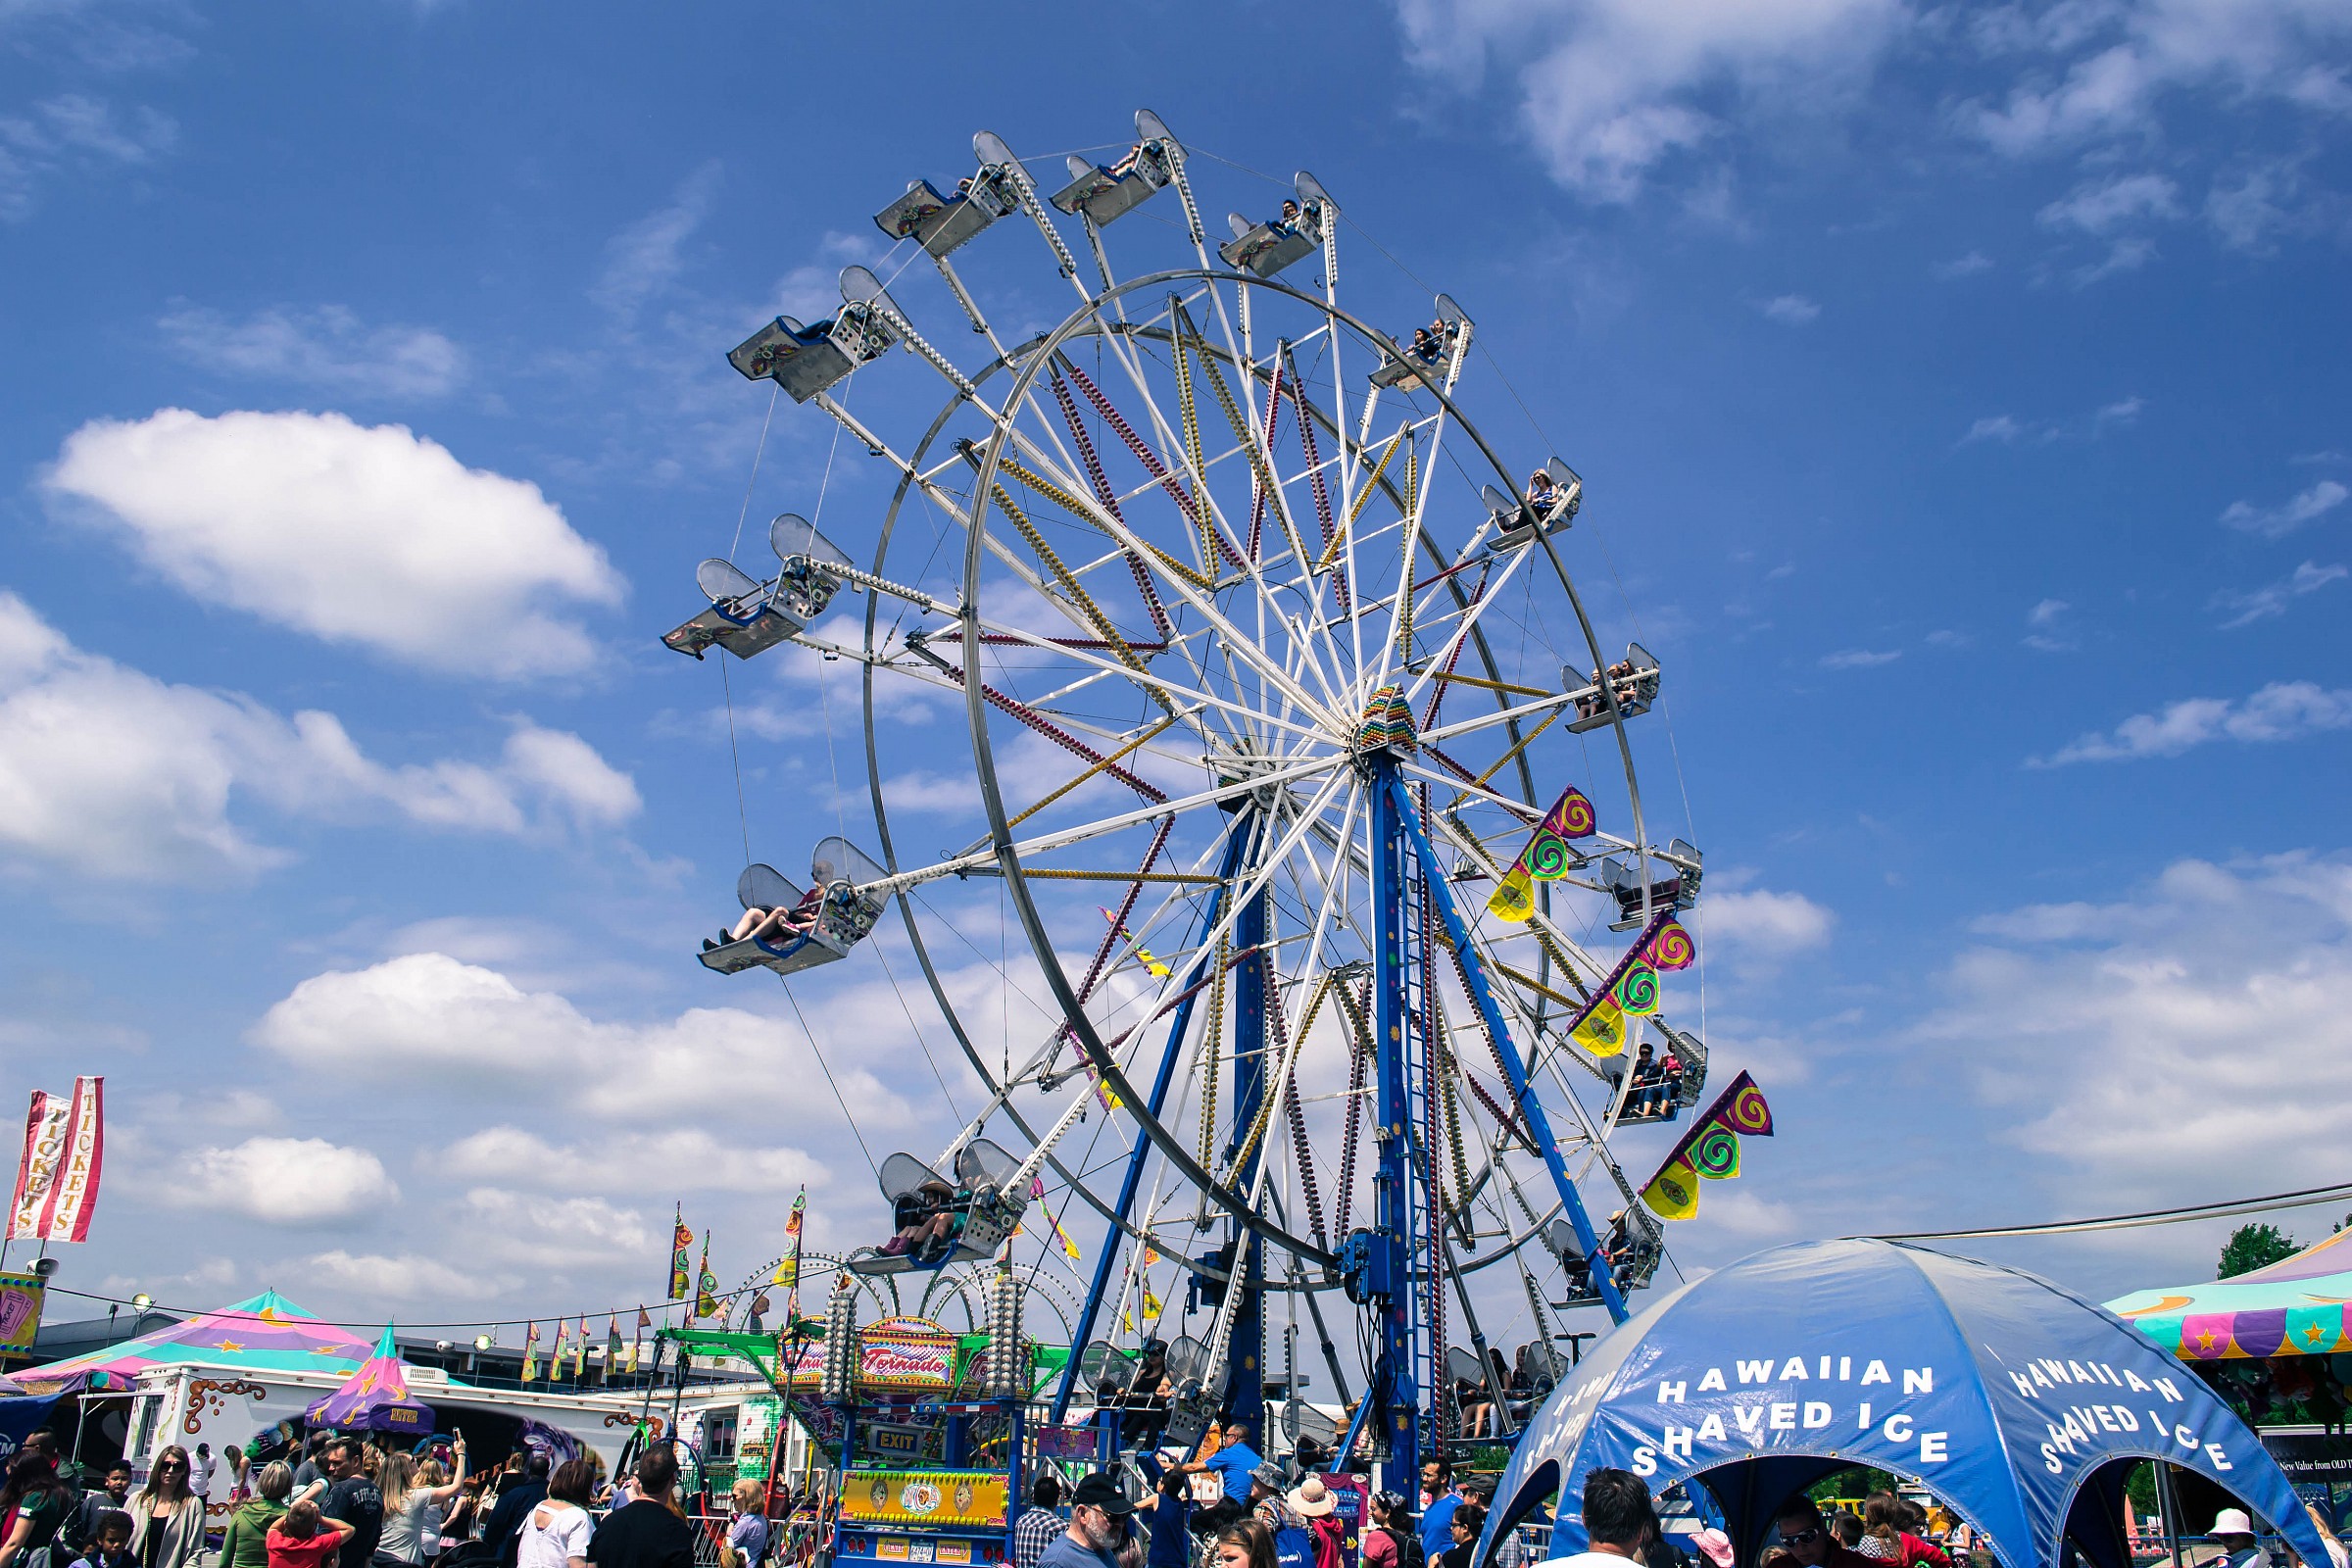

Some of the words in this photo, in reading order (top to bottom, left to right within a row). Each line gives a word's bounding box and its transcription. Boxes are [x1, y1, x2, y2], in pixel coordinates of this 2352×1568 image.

[17, 1106, 67, 1231] TICKETS
[53, 1094, 95, 1231] TICKETS
[1, 1301, 15, 1325] TICKET
[863, 1348, 947, 1373] Tornado
[1656, 1354, 1934, 1403] HAWAIIAN
[2008, 1357, 2184, 1403] HAWAIIAN
[390, 1407, 418, 1424] ENTER
[880, 1432, 914, 1449] EXIT
[1631, 1400, 1833, 1477] SHAVED
[1857, 1402, 1948, 1463] ICE
[2039, 1404, 2140, 1474] SHAVED
[2148, 1410, 2234, 1471] ICE
[2278, 1461, 2294, 1471] New
[2294, 1460, 2314, 1471] Value
[2314, 1459, 2331, 1470] from
[2331, 1459, 2347, 1469] OLD
[1333, 1490, 1361, 1503] RIS
[1333, 1505, 1359, 1517] EEL
